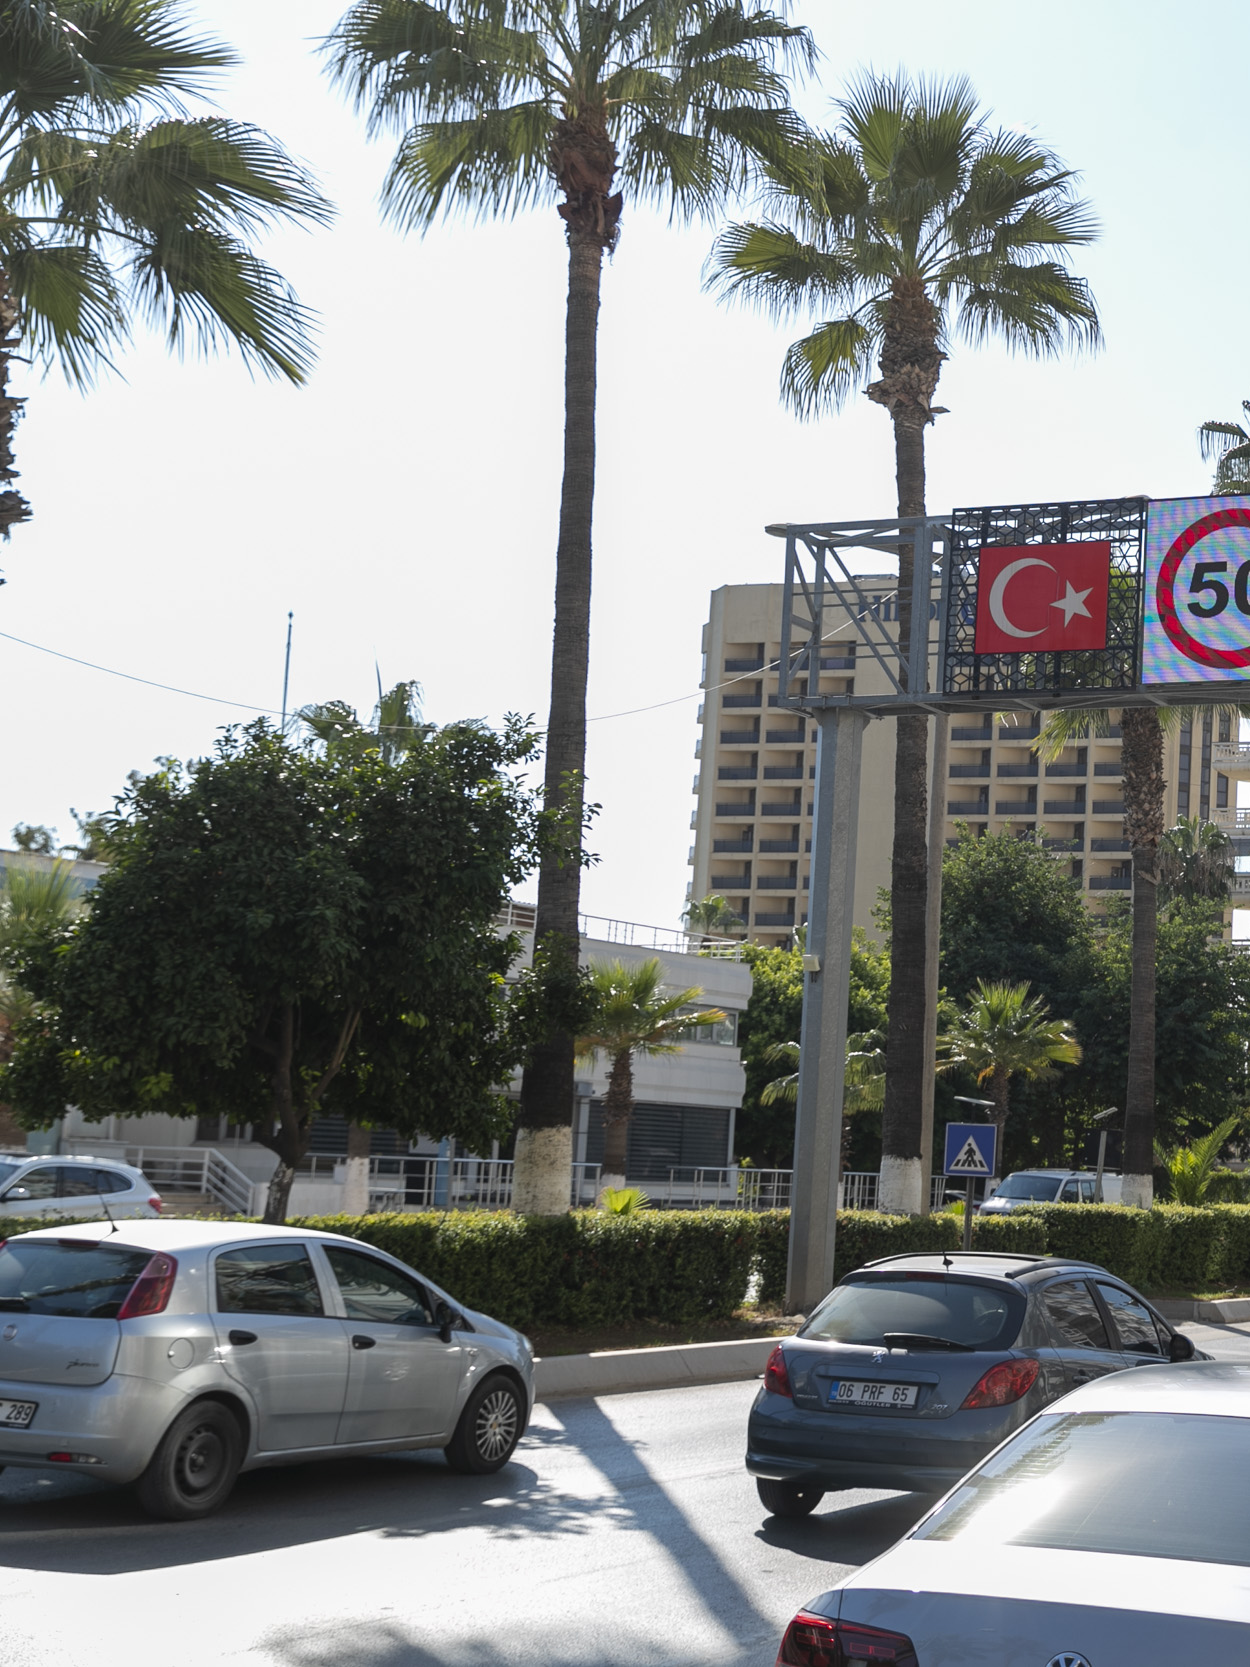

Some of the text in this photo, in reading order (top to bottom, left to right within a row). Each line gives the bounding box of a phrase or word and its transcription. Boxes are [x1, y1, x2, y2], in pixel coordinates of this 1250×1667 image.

[838, 1383, 909, 1402] 06 PRF 65
[5, 1403, 33, 1421] 289
